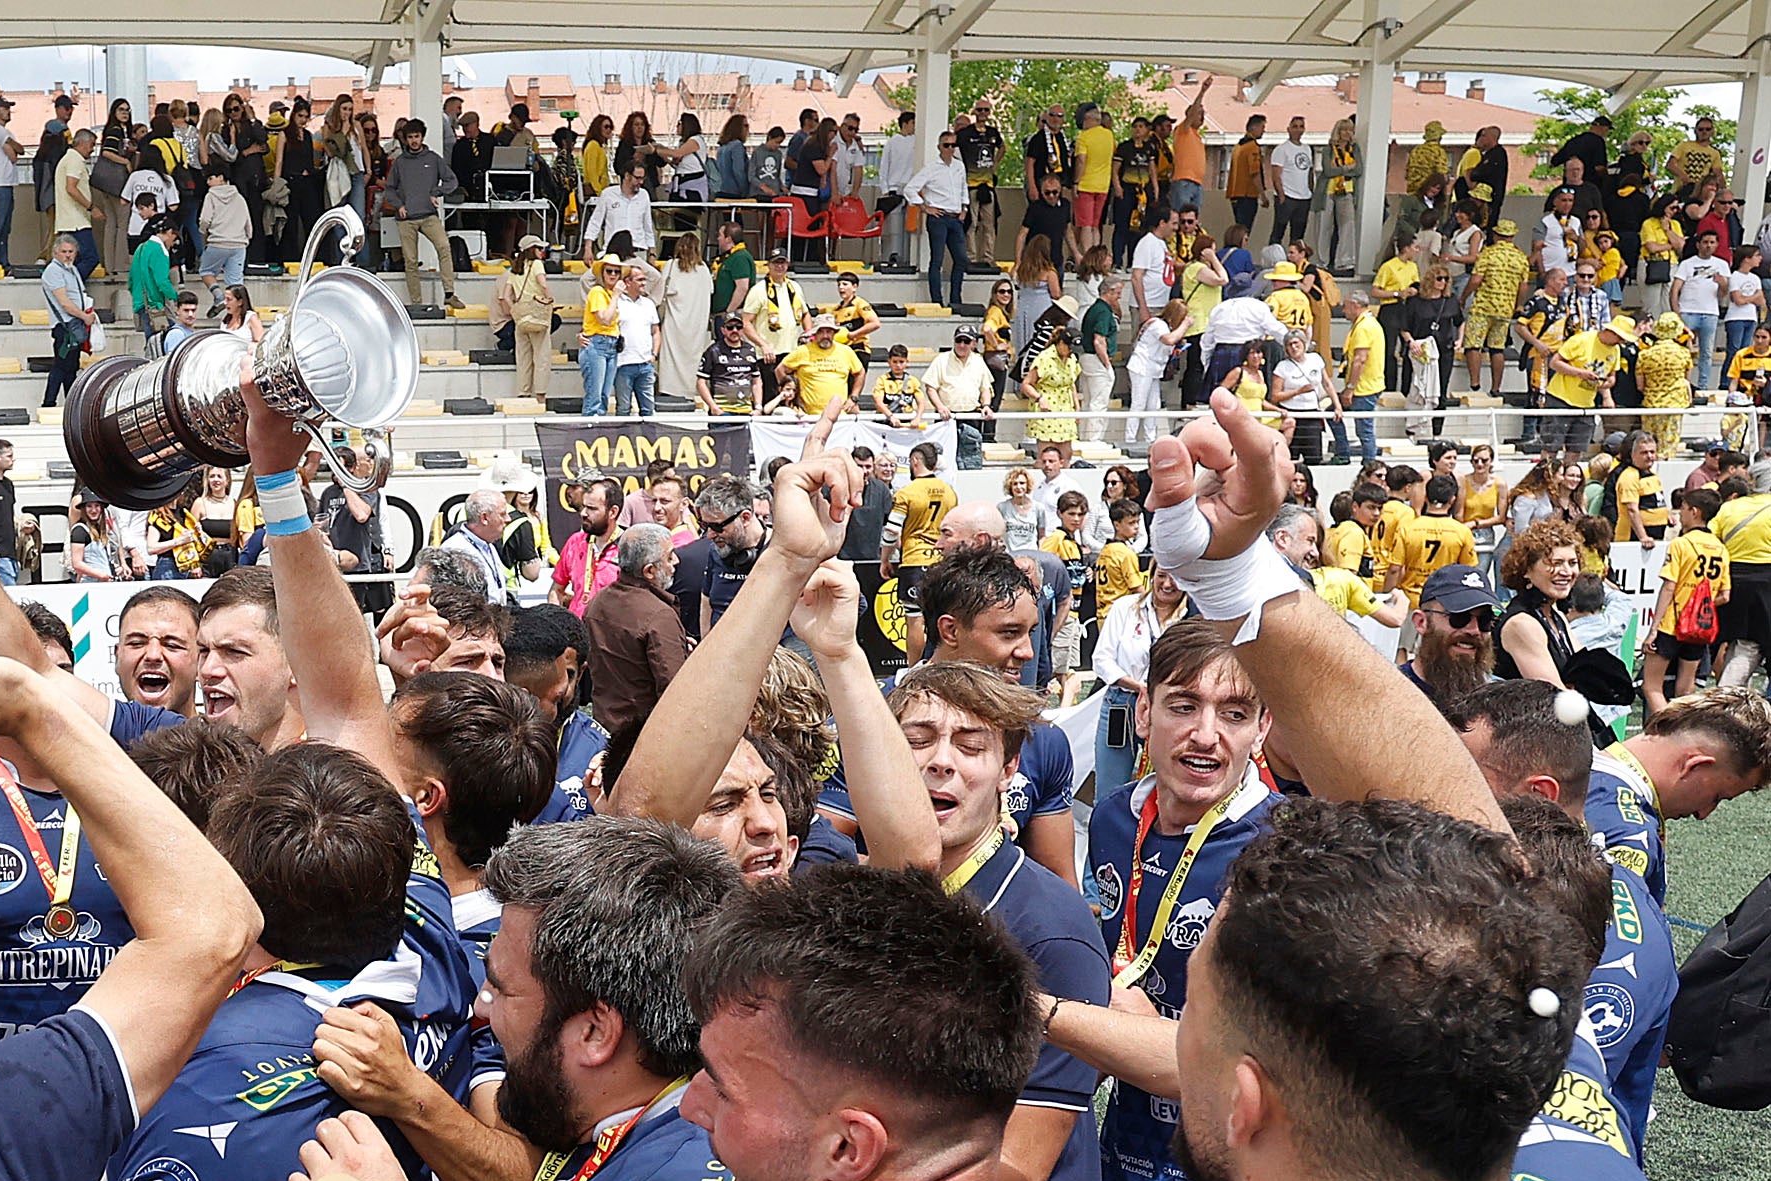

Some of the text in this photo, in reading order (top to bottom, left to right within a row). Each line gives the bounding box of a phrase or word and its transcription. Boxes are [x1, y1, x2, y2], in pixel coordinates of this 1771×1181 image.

[575, 435, 718, 469] MAMAS
[928, 500, 941, 522] 7
[1425, 540, 1441, 564] 7
[1693, 554, 1723, 580] 35
[1141, 861, 1168, 878] ERCURY
[1611, 881, 1640, 941] RKD
[171, 1164, 186, 1177] DE
